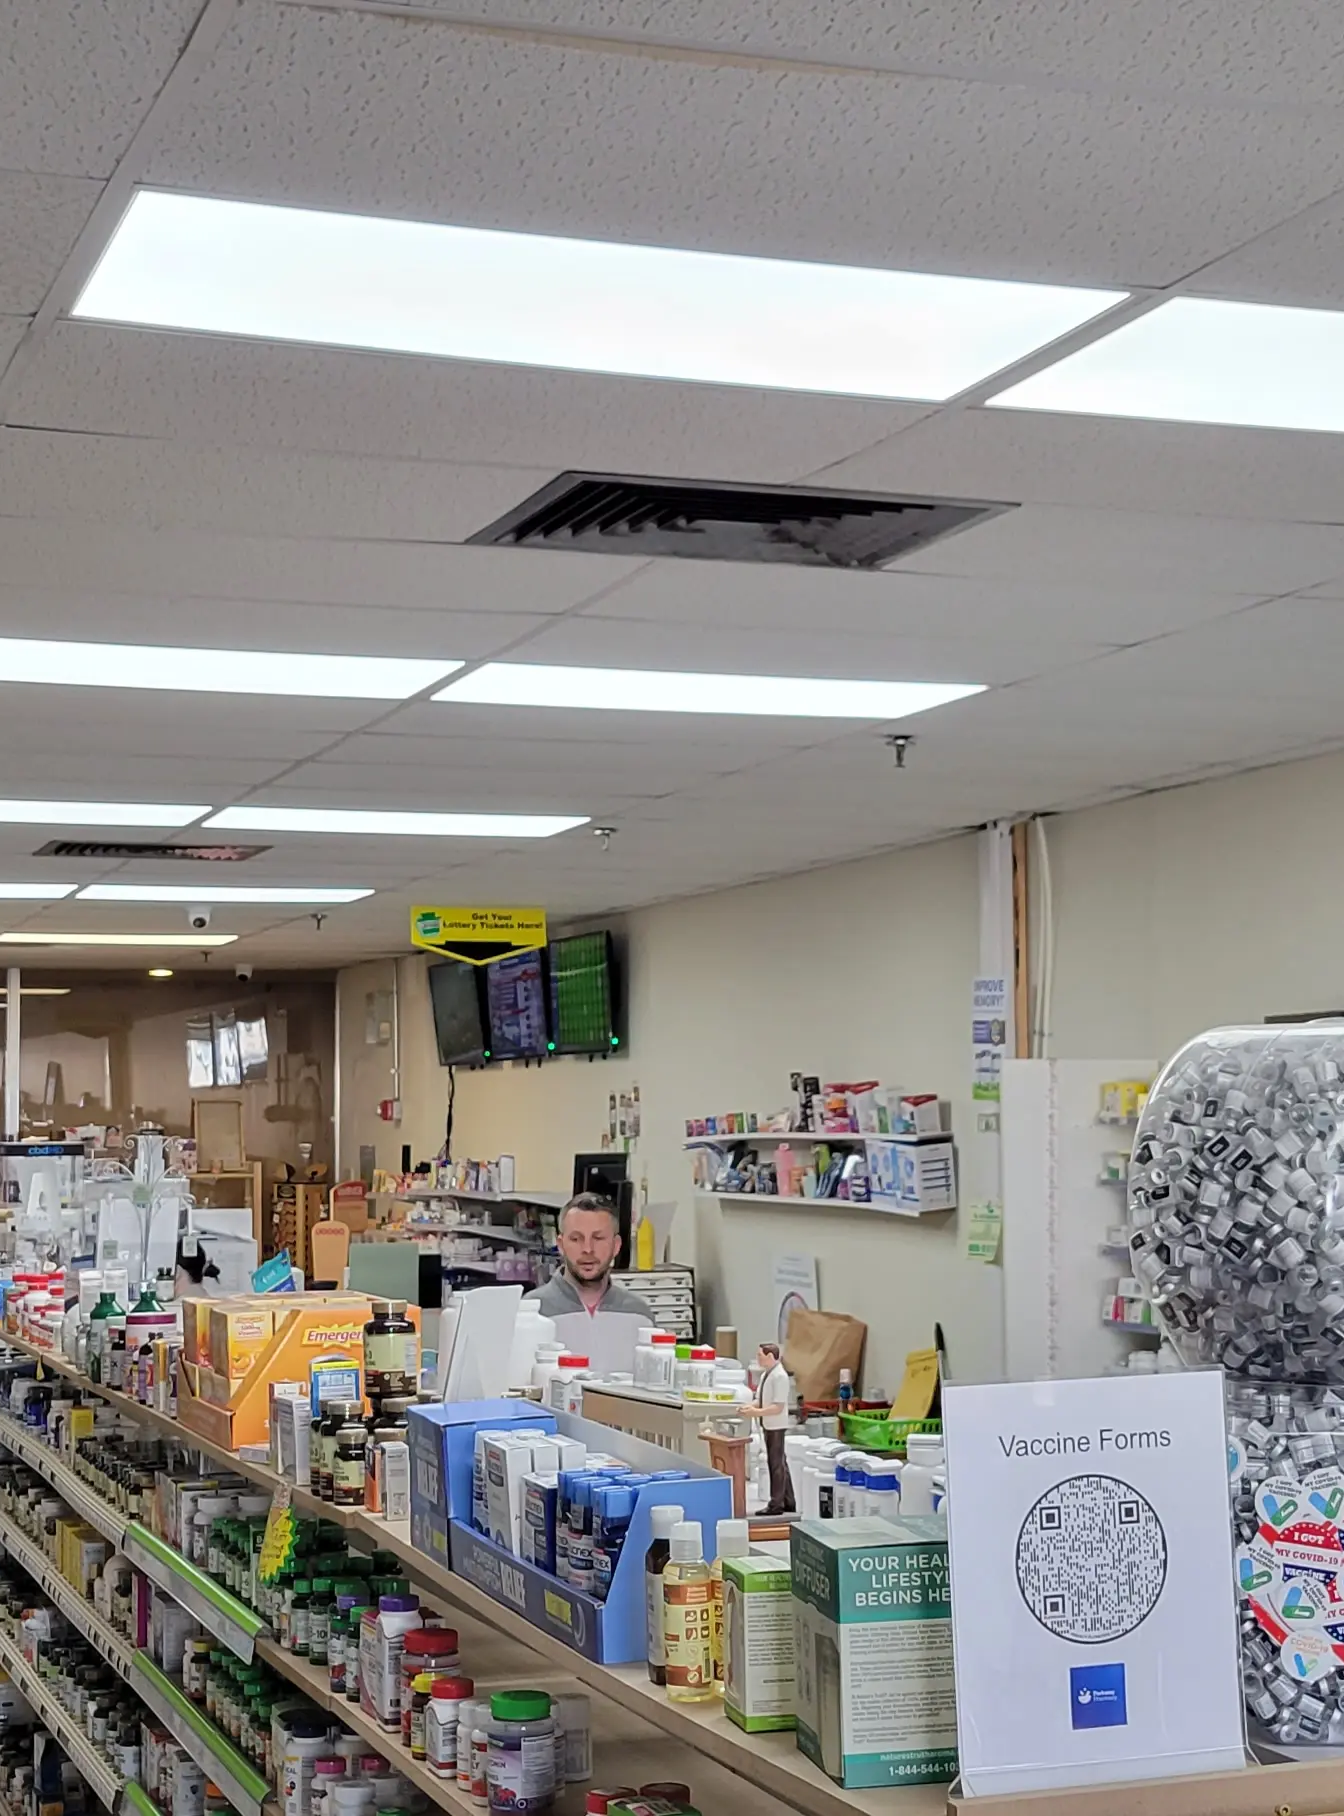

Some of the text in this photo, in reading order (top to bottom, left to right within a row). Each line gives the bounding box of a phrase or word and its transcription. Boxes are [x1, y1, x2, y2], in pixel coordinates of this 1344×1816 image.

[491, 912, 513, 922] Your
[442, 921, 477, 931] Lottery
[479, 921, 515, 930] Tickets
[998, 1427, 1171, 1457] Vaccine Forms
[1293, 1532, 1325, 1544] I GOT
[849, 1553, 950, 1572] YOUR HEAL
[1275, 1548, 1339, 1565] MY COVID-19
[795, 1559, 831, 1601] DIFFUSER
[1284, 1567, 1327, 1581] VACCINE
[855, 1587, 951, 1607] BEGINS HE
[888, 1762, 960, 1777] 1-844-544-10
